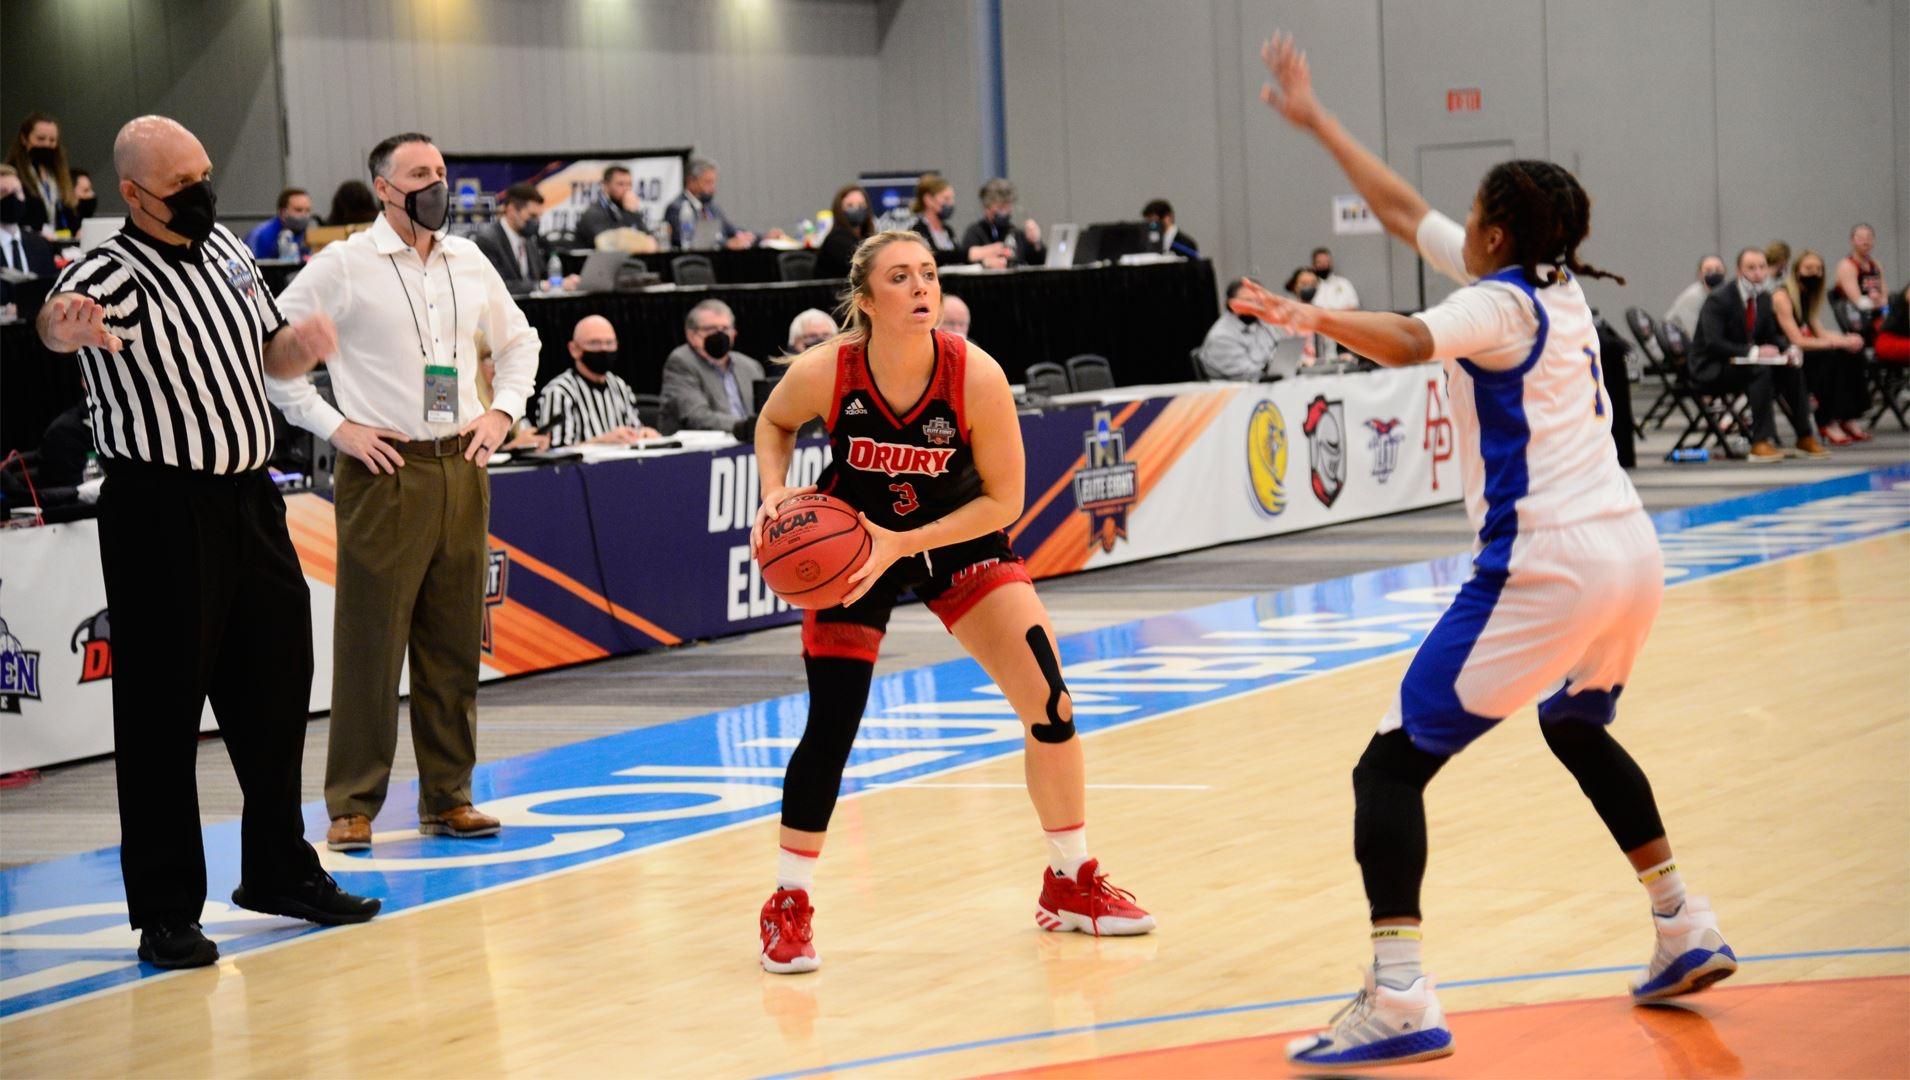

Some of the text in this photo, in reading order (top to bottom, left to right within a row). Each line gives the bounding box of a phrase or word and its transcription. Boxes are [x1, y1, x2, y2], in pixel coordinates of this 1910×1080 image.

[1582, 344, 1605, 417] 1
[847, 436, 956, 478] DRURY
[888, 481, 920, 517] 3
[768, 510, 819, 544] NCAA
